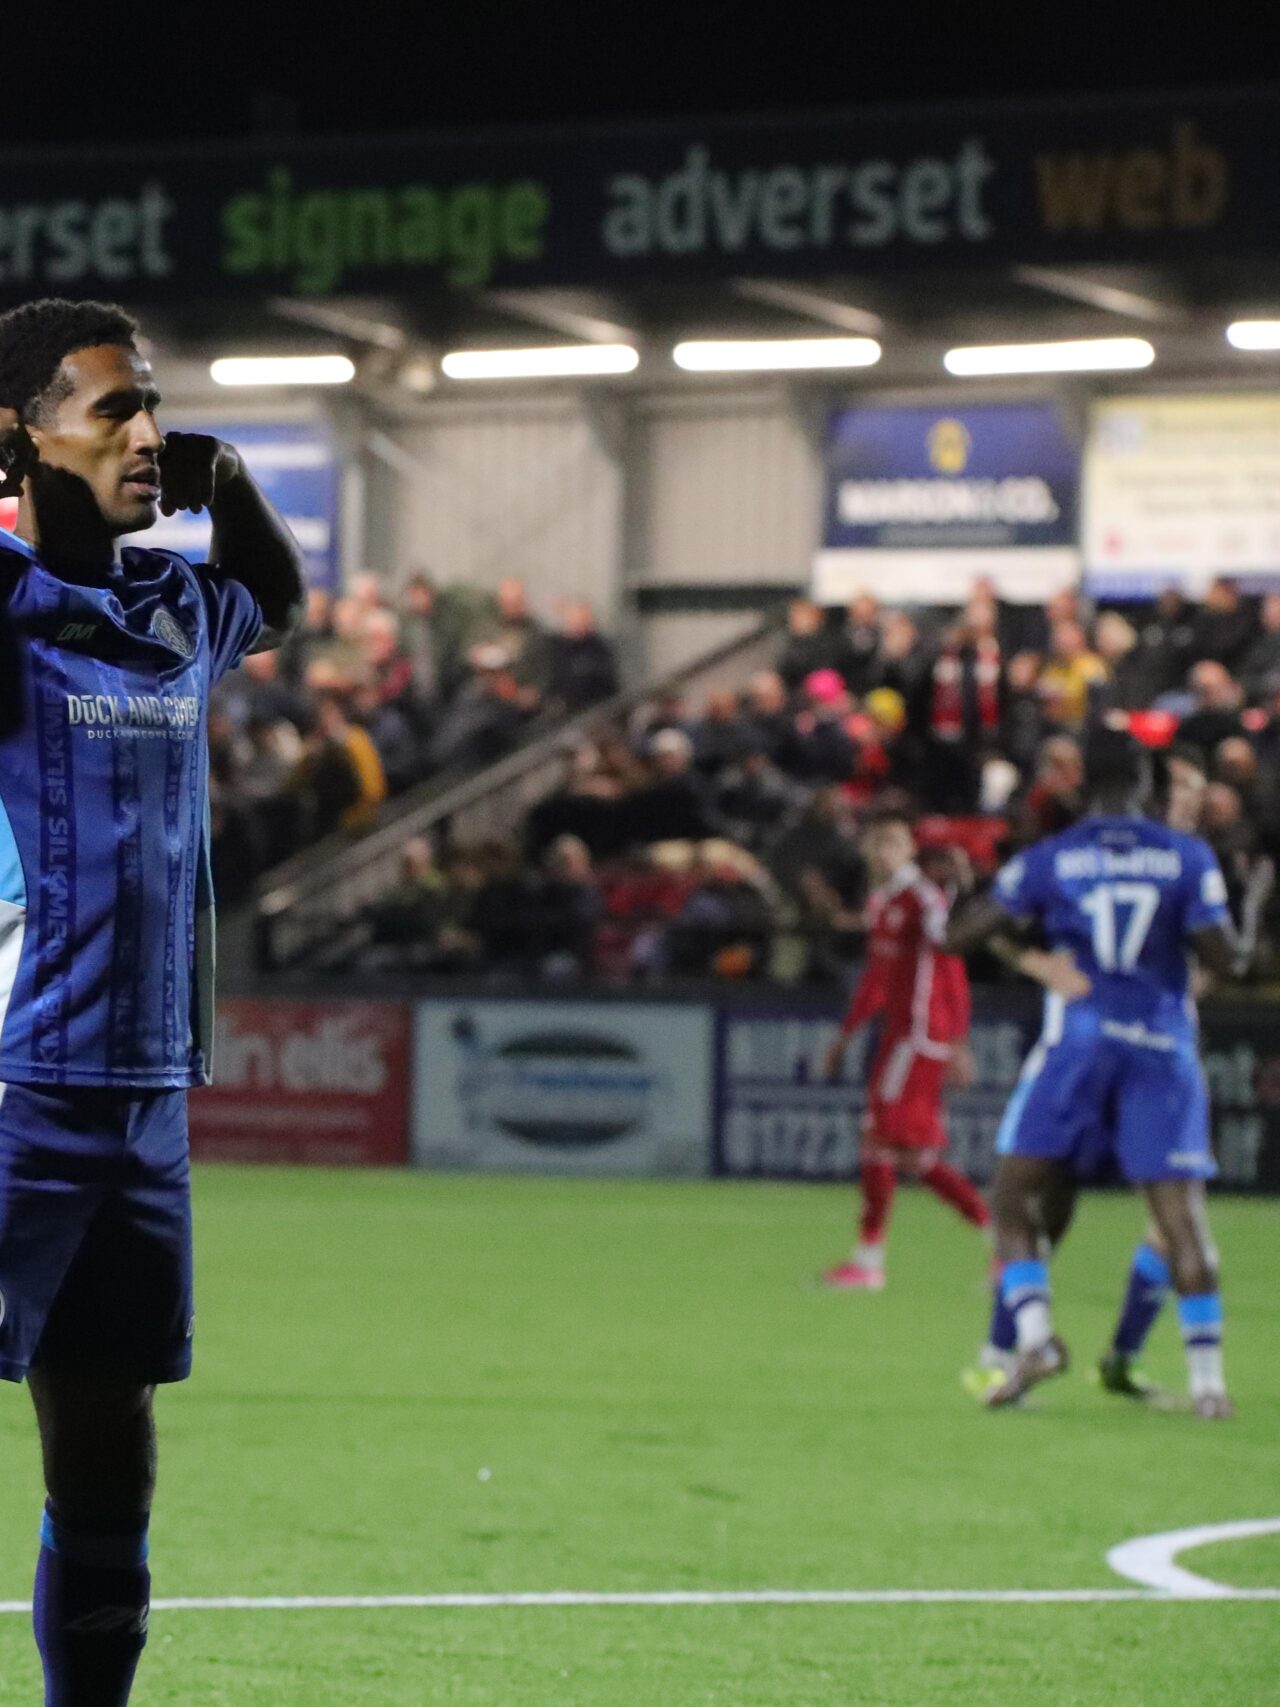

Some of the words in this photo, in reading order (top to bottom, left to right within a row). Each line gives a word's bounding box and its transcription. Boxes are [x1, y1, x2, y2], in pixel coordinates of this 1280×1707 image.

[222, 170, 546, 289] signage
[604, 142, 993, 256] adverset
[1036, 123, 1229, 229] web
[127, 696, 162, 726] AND
[1081, 883, 1160, 972] 17
